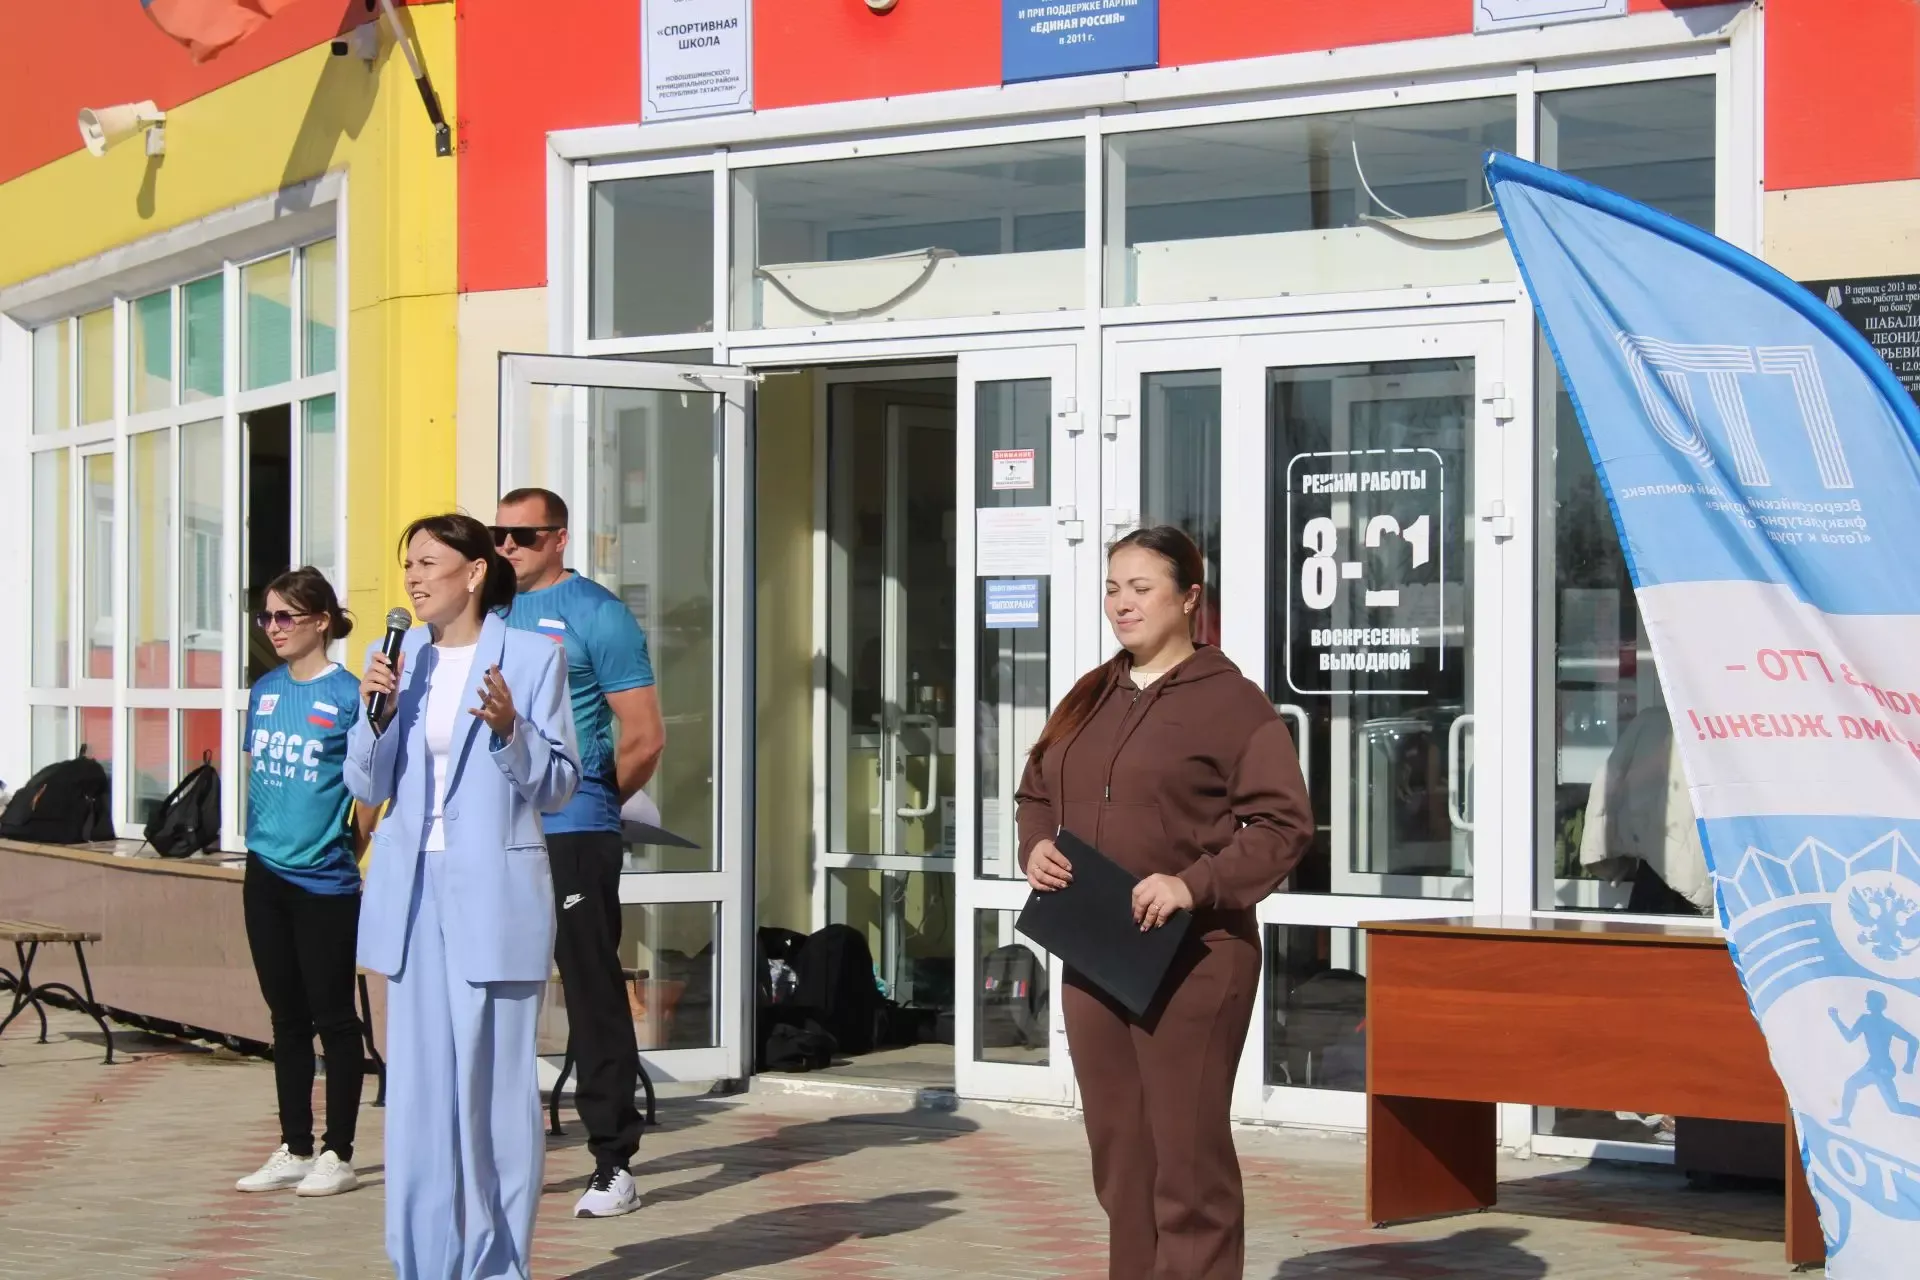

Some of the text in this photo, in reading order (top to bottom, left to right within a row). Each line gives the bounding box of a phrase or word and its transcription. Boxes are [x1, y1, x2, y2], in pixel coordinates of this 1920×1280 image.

[1019, 10, 1025, 19] И
[1027, 8, 1045, 18] ПРИ
[1046, 1, 1101, 16] ПОДДЕРЖКЕ
[657, 18, 738, 36] «СПОРТИВНАЯ
[1030, 13, 1125, 33] «ЕДИНАЯ РОССИЯ»
[679, 36, 720, 50] ШКОЛА
[1059, 33, 1095, 45] в 2011 г.
[656, 76, 740, 90] МУНИЦИПАЛЬНОГО РАЙОНА
[659, 88, 698, 99] РЕСПУБЛИКИ
[1845, 285, 1851, 295] В
[1853, 286, 1880, 296] период
[1887, 281, 1905, 292] 2013
[1907, 283, 1917, 291] по
[1852, 296, 1872, 304] здесь
[1873, 293, 1903, 305] работал
[1890, 302, 1912, 313] боксу
[1303, 470, 1426, 494] РЕЖИМ РАБОТЫ
[1311, 628, 1420, 647] ВОСКРЕСЕНЬЕ
[1320, 650, 1411, 672] ВЫХОДНОЙ
[251, 729, 324, 767] РОСС
